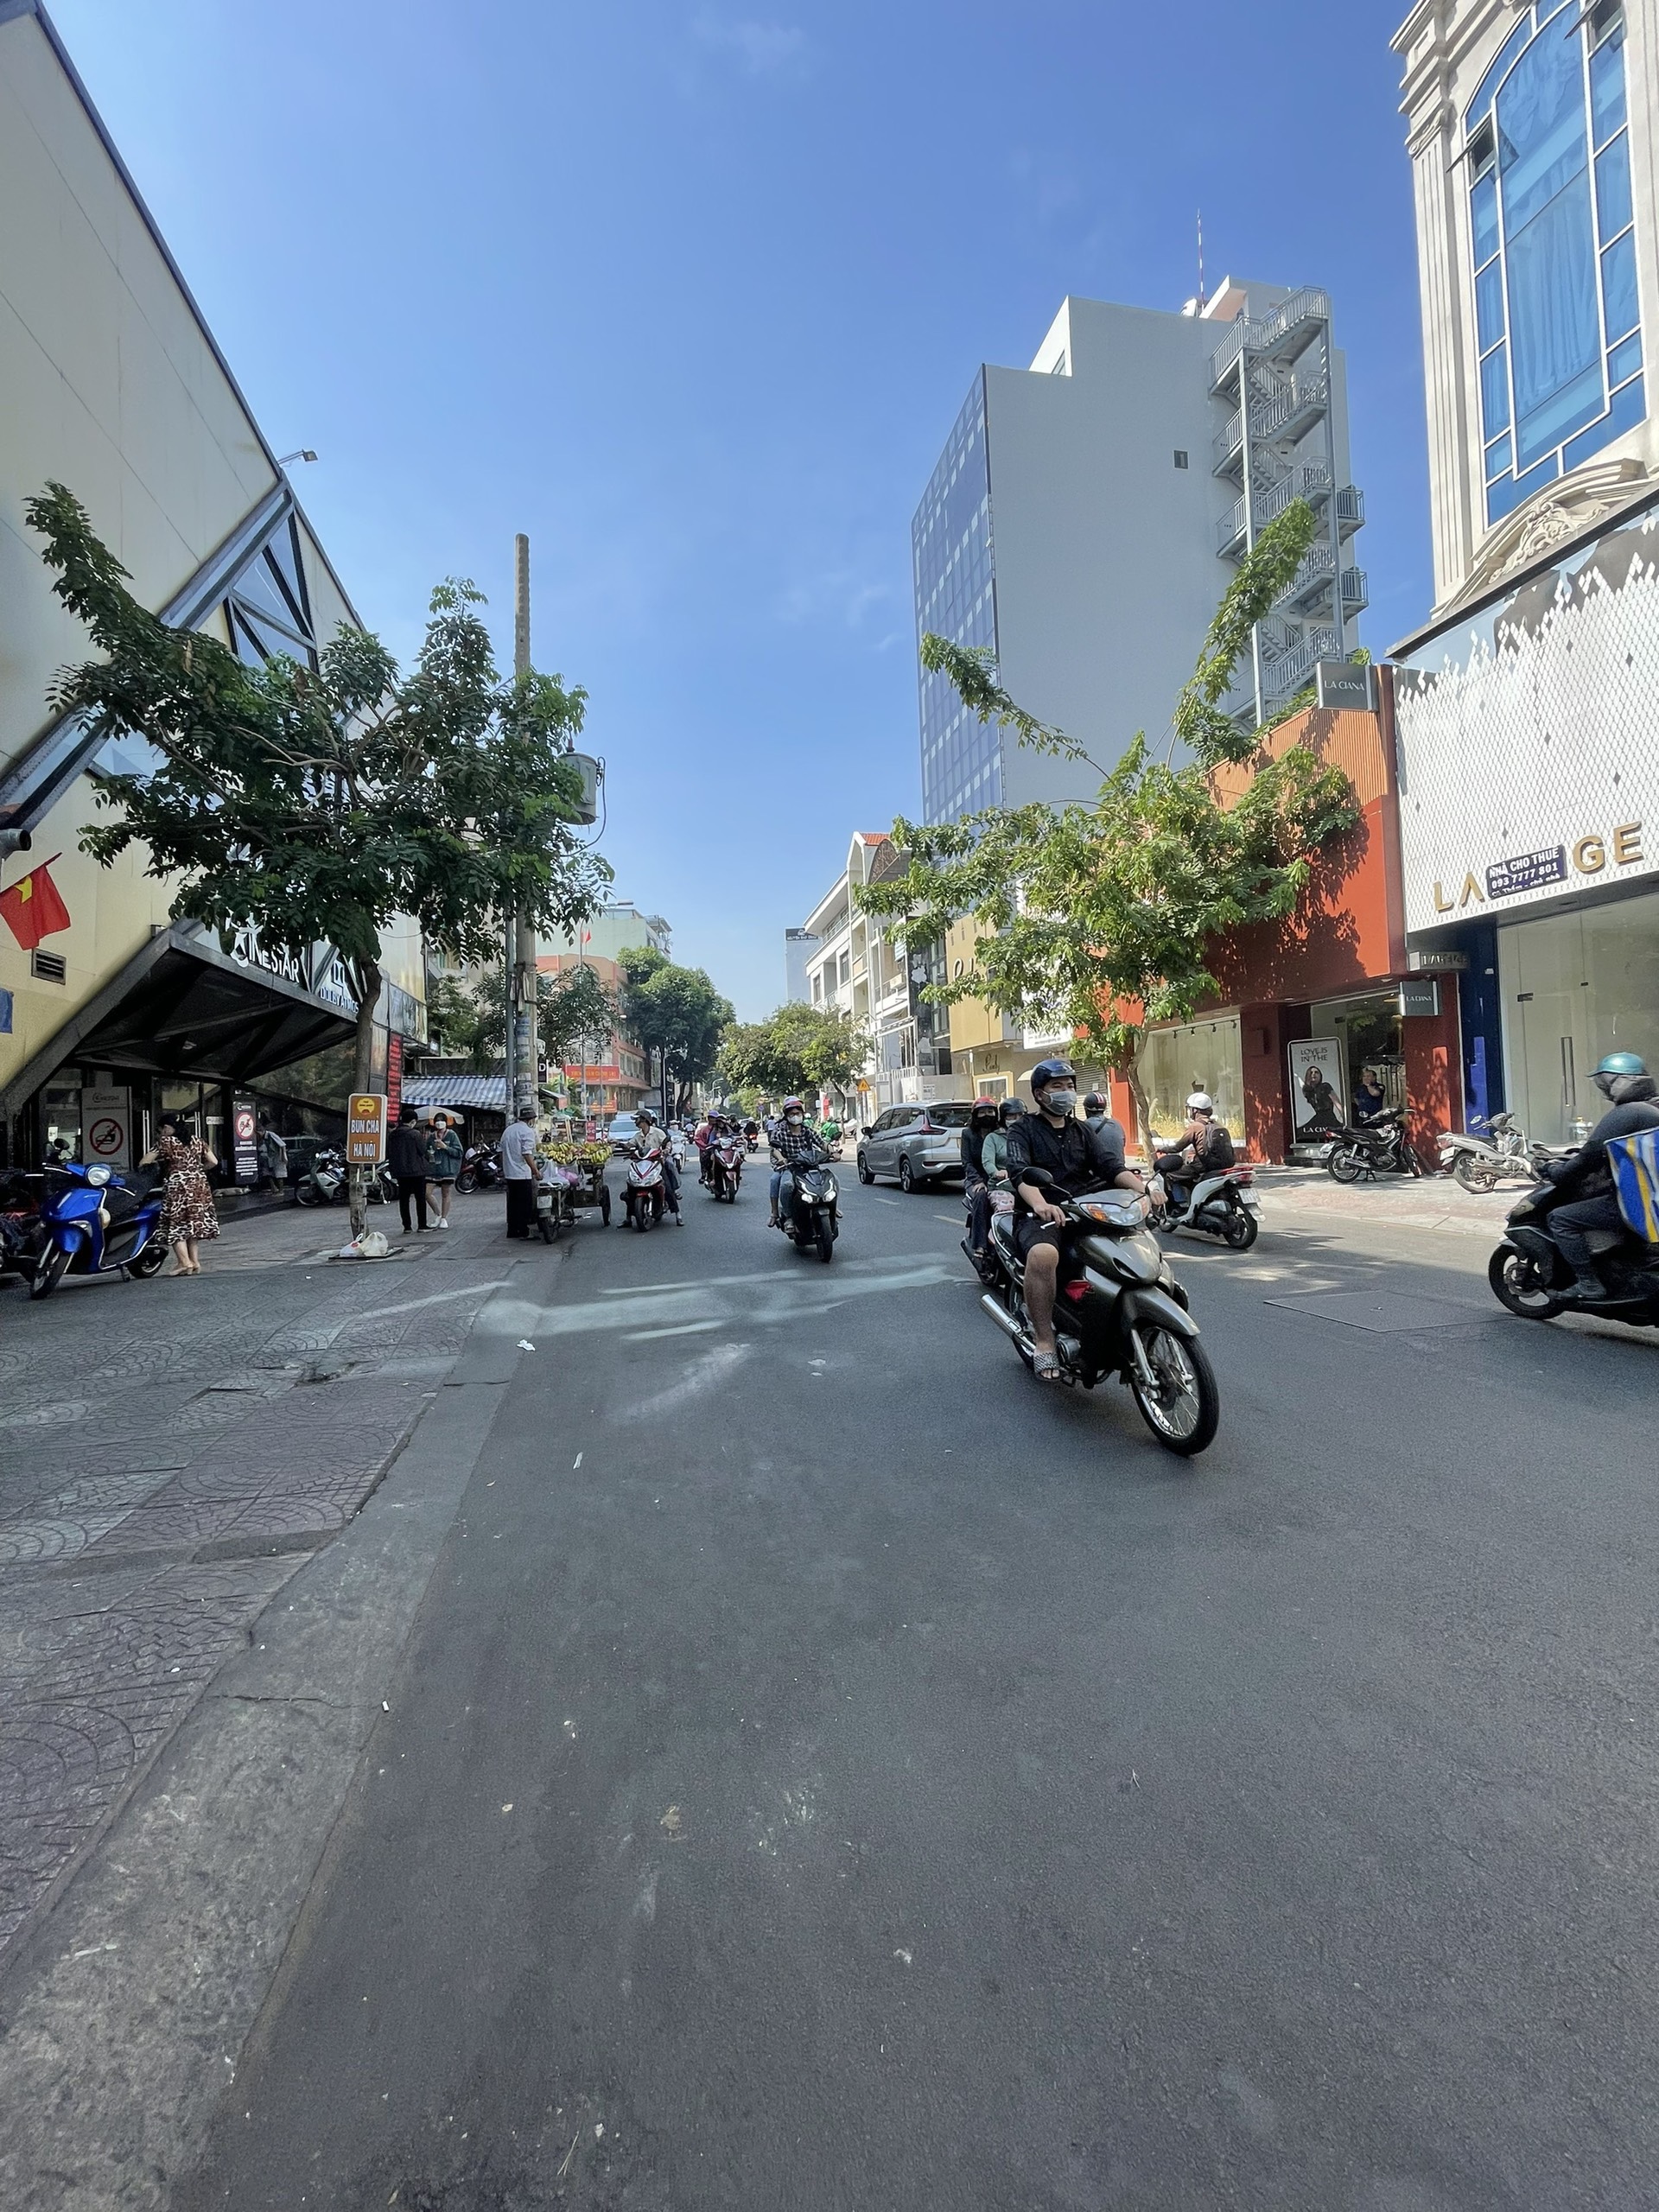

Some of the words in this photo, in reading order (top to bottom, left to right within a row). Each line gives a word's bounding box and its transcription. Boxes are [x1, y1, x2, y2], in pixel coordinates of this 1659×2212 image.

[1324, 680, 1337, 689] LA
[1510, 857, 1530, 872] CHO
[1491, 876, 1510, 889] 093
[1511, 868, 1535, 883] 7777
[1538, 862, 1558, 875] 801
[321, 987, 340, 1006] DOLBY
[340, 995, 359, 1014] ATMOS
